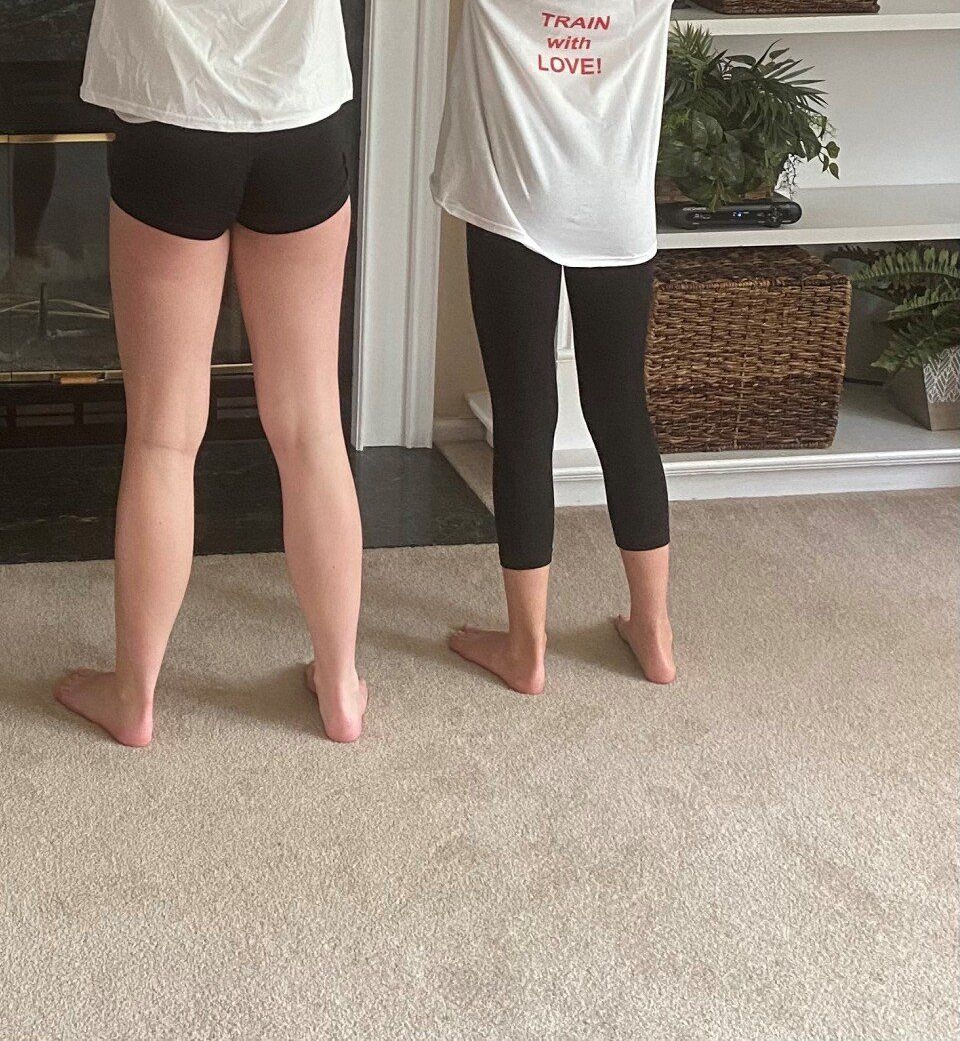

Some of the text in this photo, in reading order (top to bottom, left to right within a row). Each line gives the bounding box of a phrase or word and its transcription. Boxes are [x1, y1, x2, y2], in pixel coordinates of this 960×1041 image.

[541, 12, 611, 30] TRAIN
[547, 35, 592, 50] with
[538, 54, 602, 75] LOVE!
